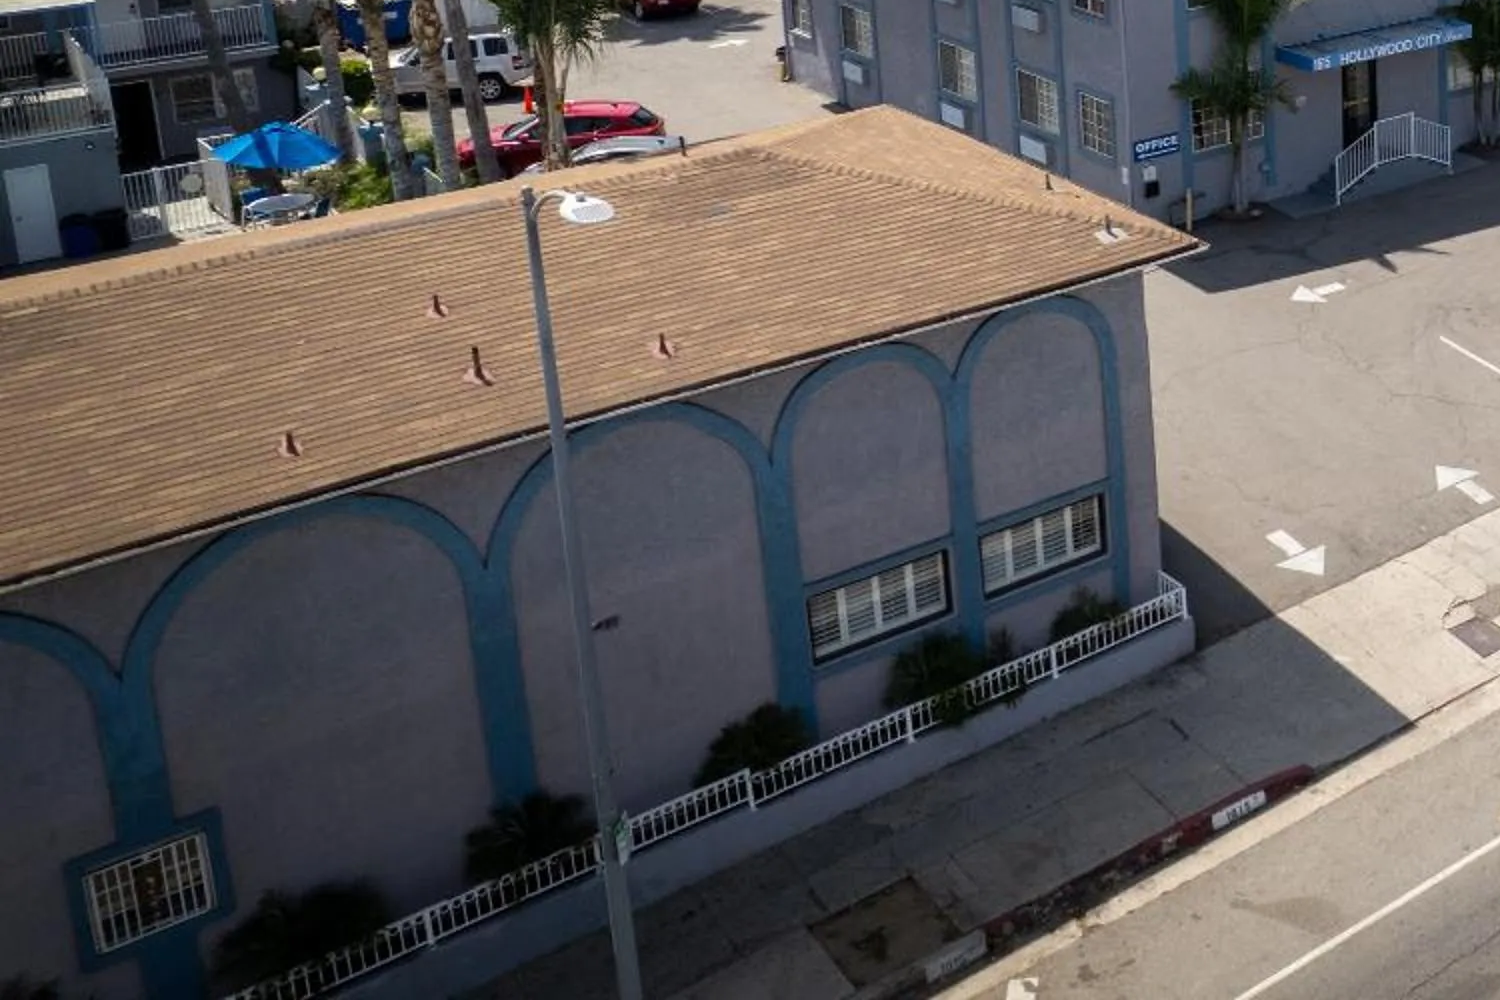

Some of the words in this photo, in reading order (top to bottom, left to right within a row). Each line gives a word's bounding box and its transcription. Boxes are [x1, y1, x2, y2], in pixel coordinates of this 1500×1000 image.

[1340, 39, 1413, 66] HOLLYWOOD
[1415, 31, 1442, 50] CITY
[1136, 135, 1179, 153] OFFICE
